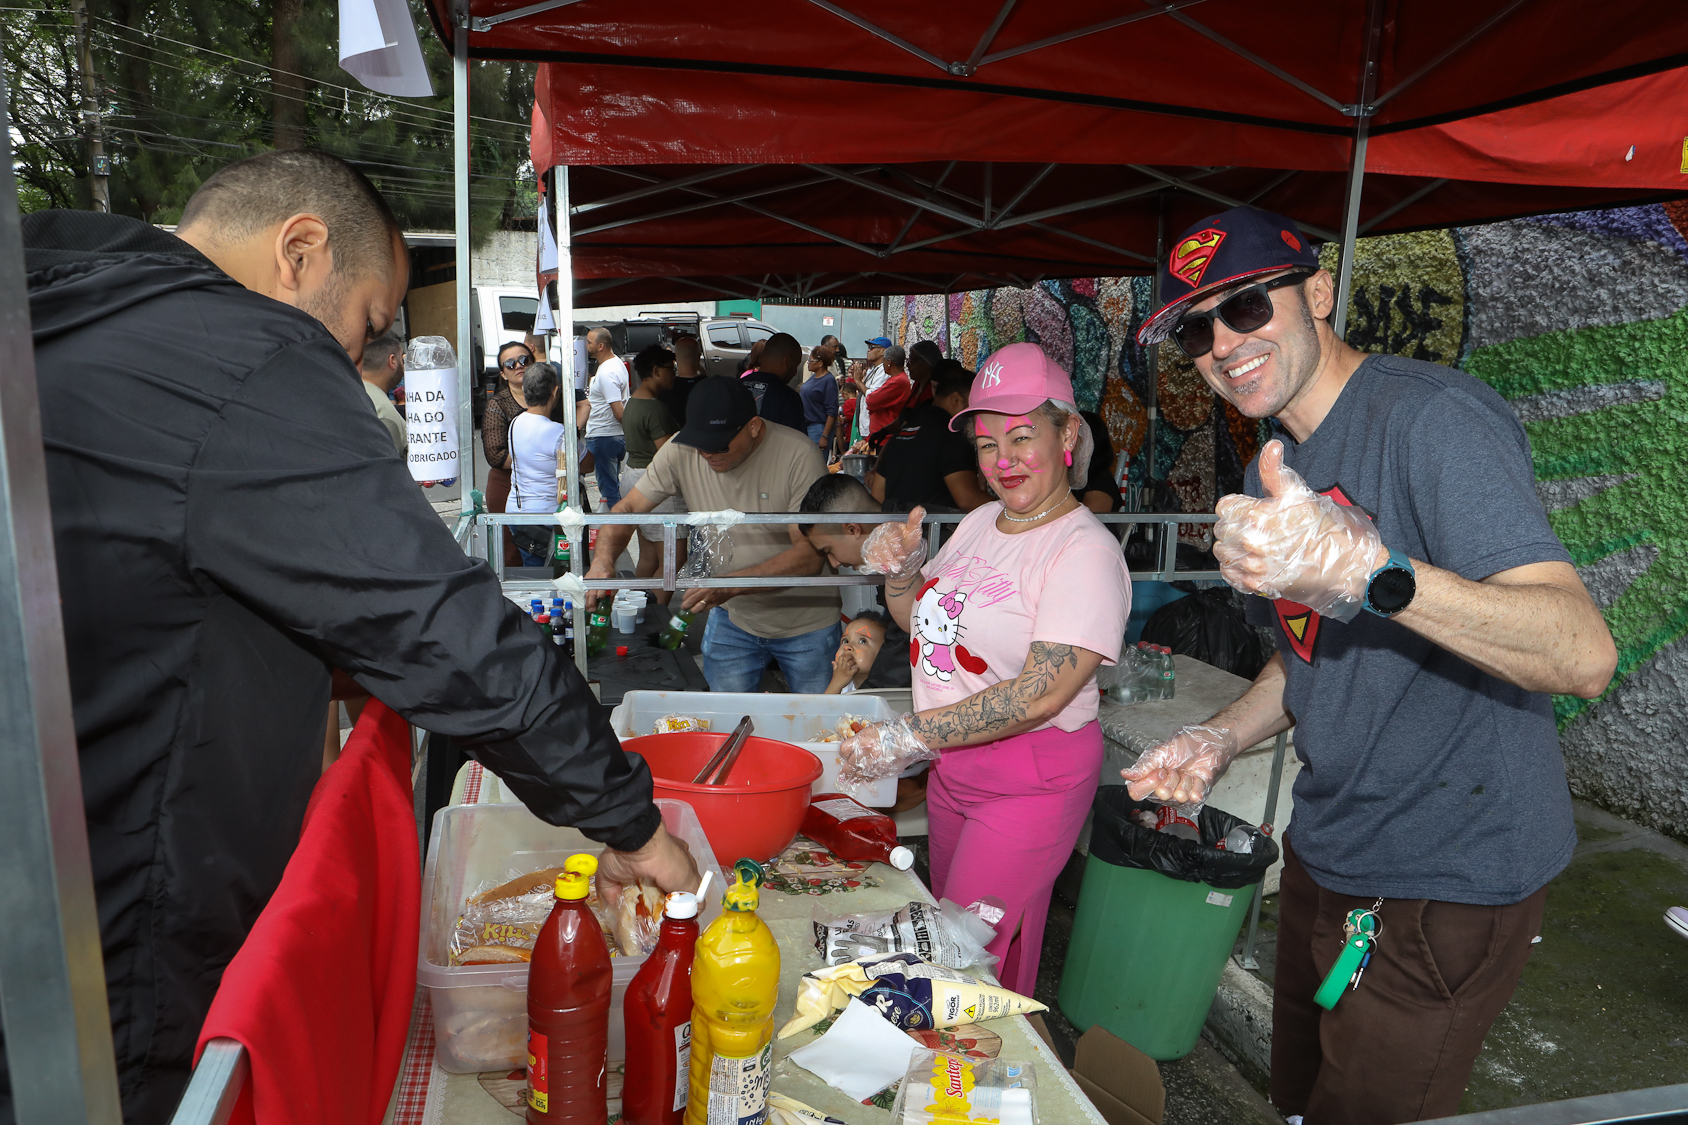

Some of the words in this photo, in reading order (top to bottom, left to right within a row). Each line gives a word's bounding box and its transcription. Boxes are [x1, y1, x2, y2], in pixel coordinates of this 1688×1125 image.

[981, 361, 1004, 390] NY
[426, 390, 445, 402] DA
[424, 411, 444, 423] DO
[946, 996, 957, 1020] VIGOR
[945, 1057, 963, 1098] Santep
